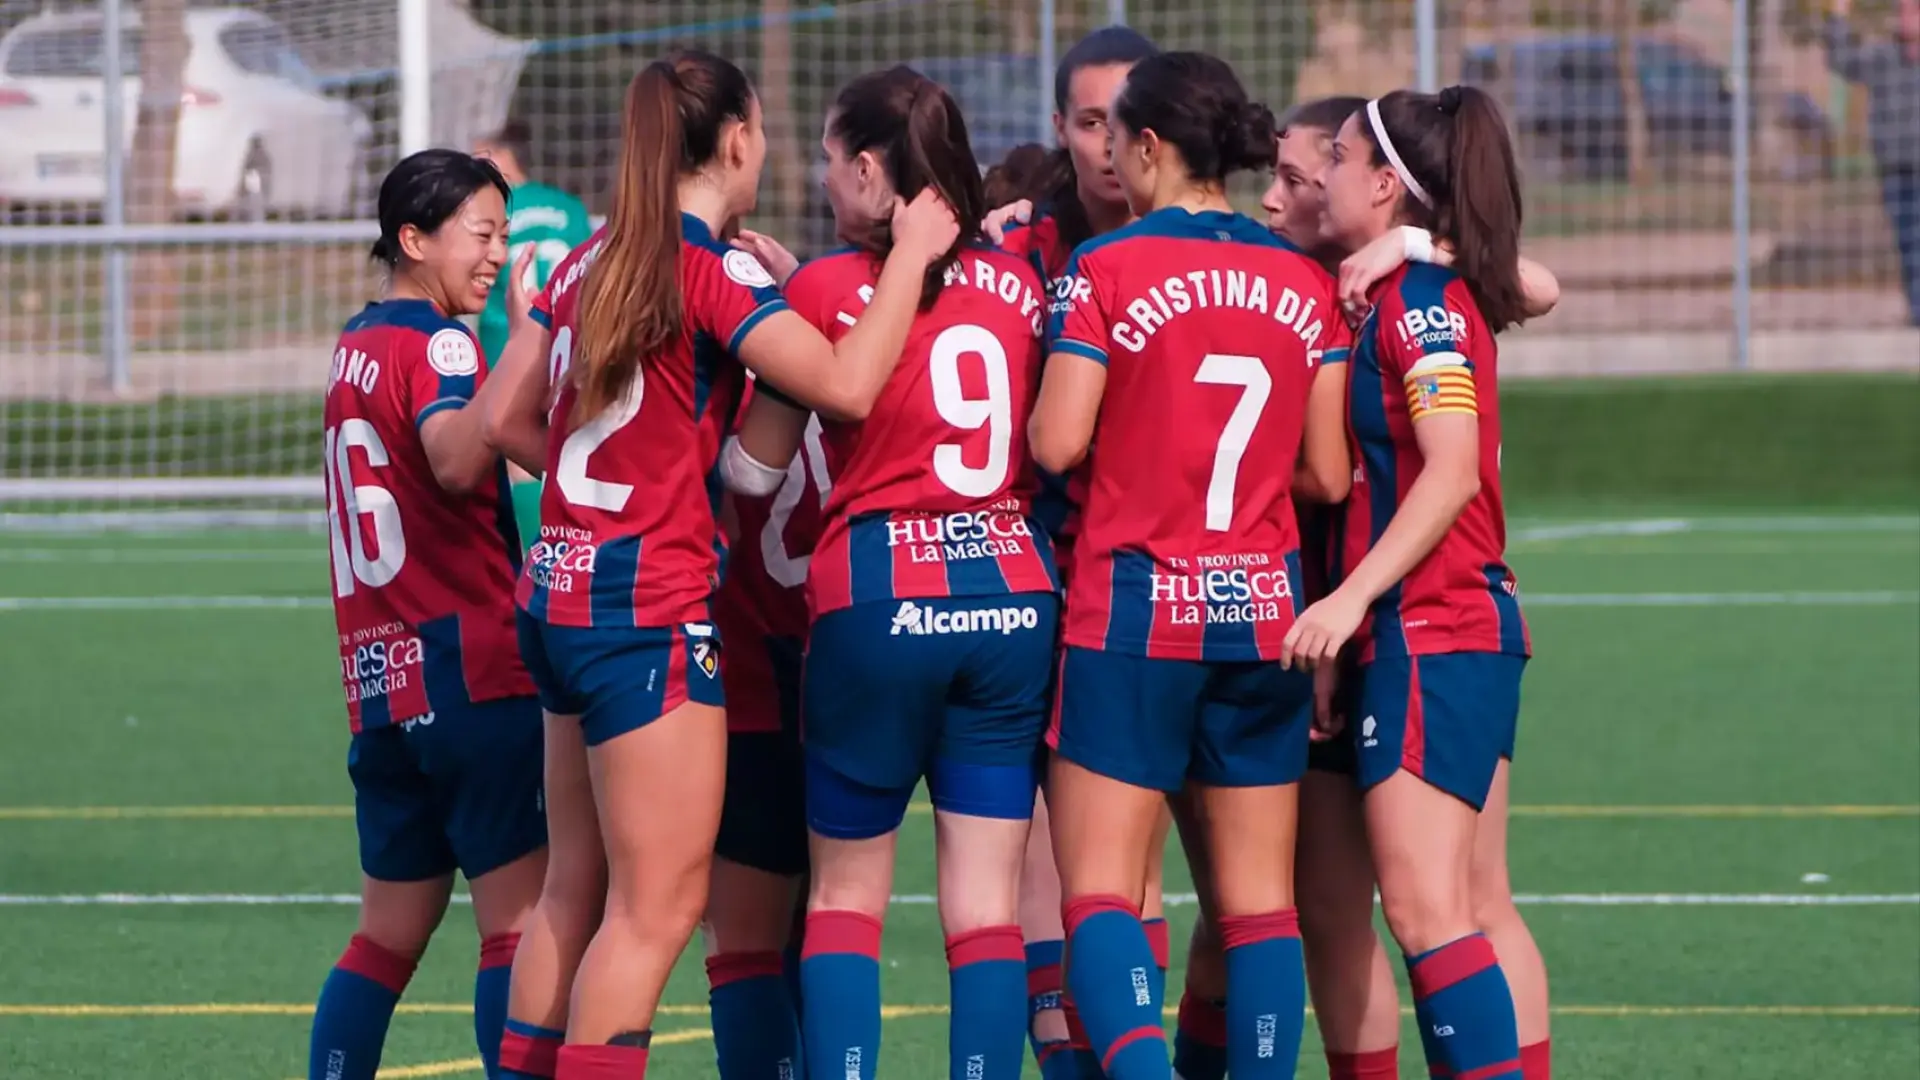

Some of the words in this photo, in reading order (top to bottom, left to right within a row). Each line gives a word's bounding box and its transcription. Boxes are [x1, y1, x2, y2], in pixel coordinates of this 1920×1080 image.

[1112, 269, 1268, 353] CRISTINA
[929, 324, 1012, 498] 9
[1193, 354, 1273, 532] 7
[326, 418, 406, 598] 16
[885, 510, 1033, 546] Huesca
[911, 543, 941, 563] La
[1149, 569, 1293, 602] Huesca
[890, 601, 1039, 635] Alcampo
[1171, 605, 1200, 624] La
[340, 637, 425, 681] uesca
